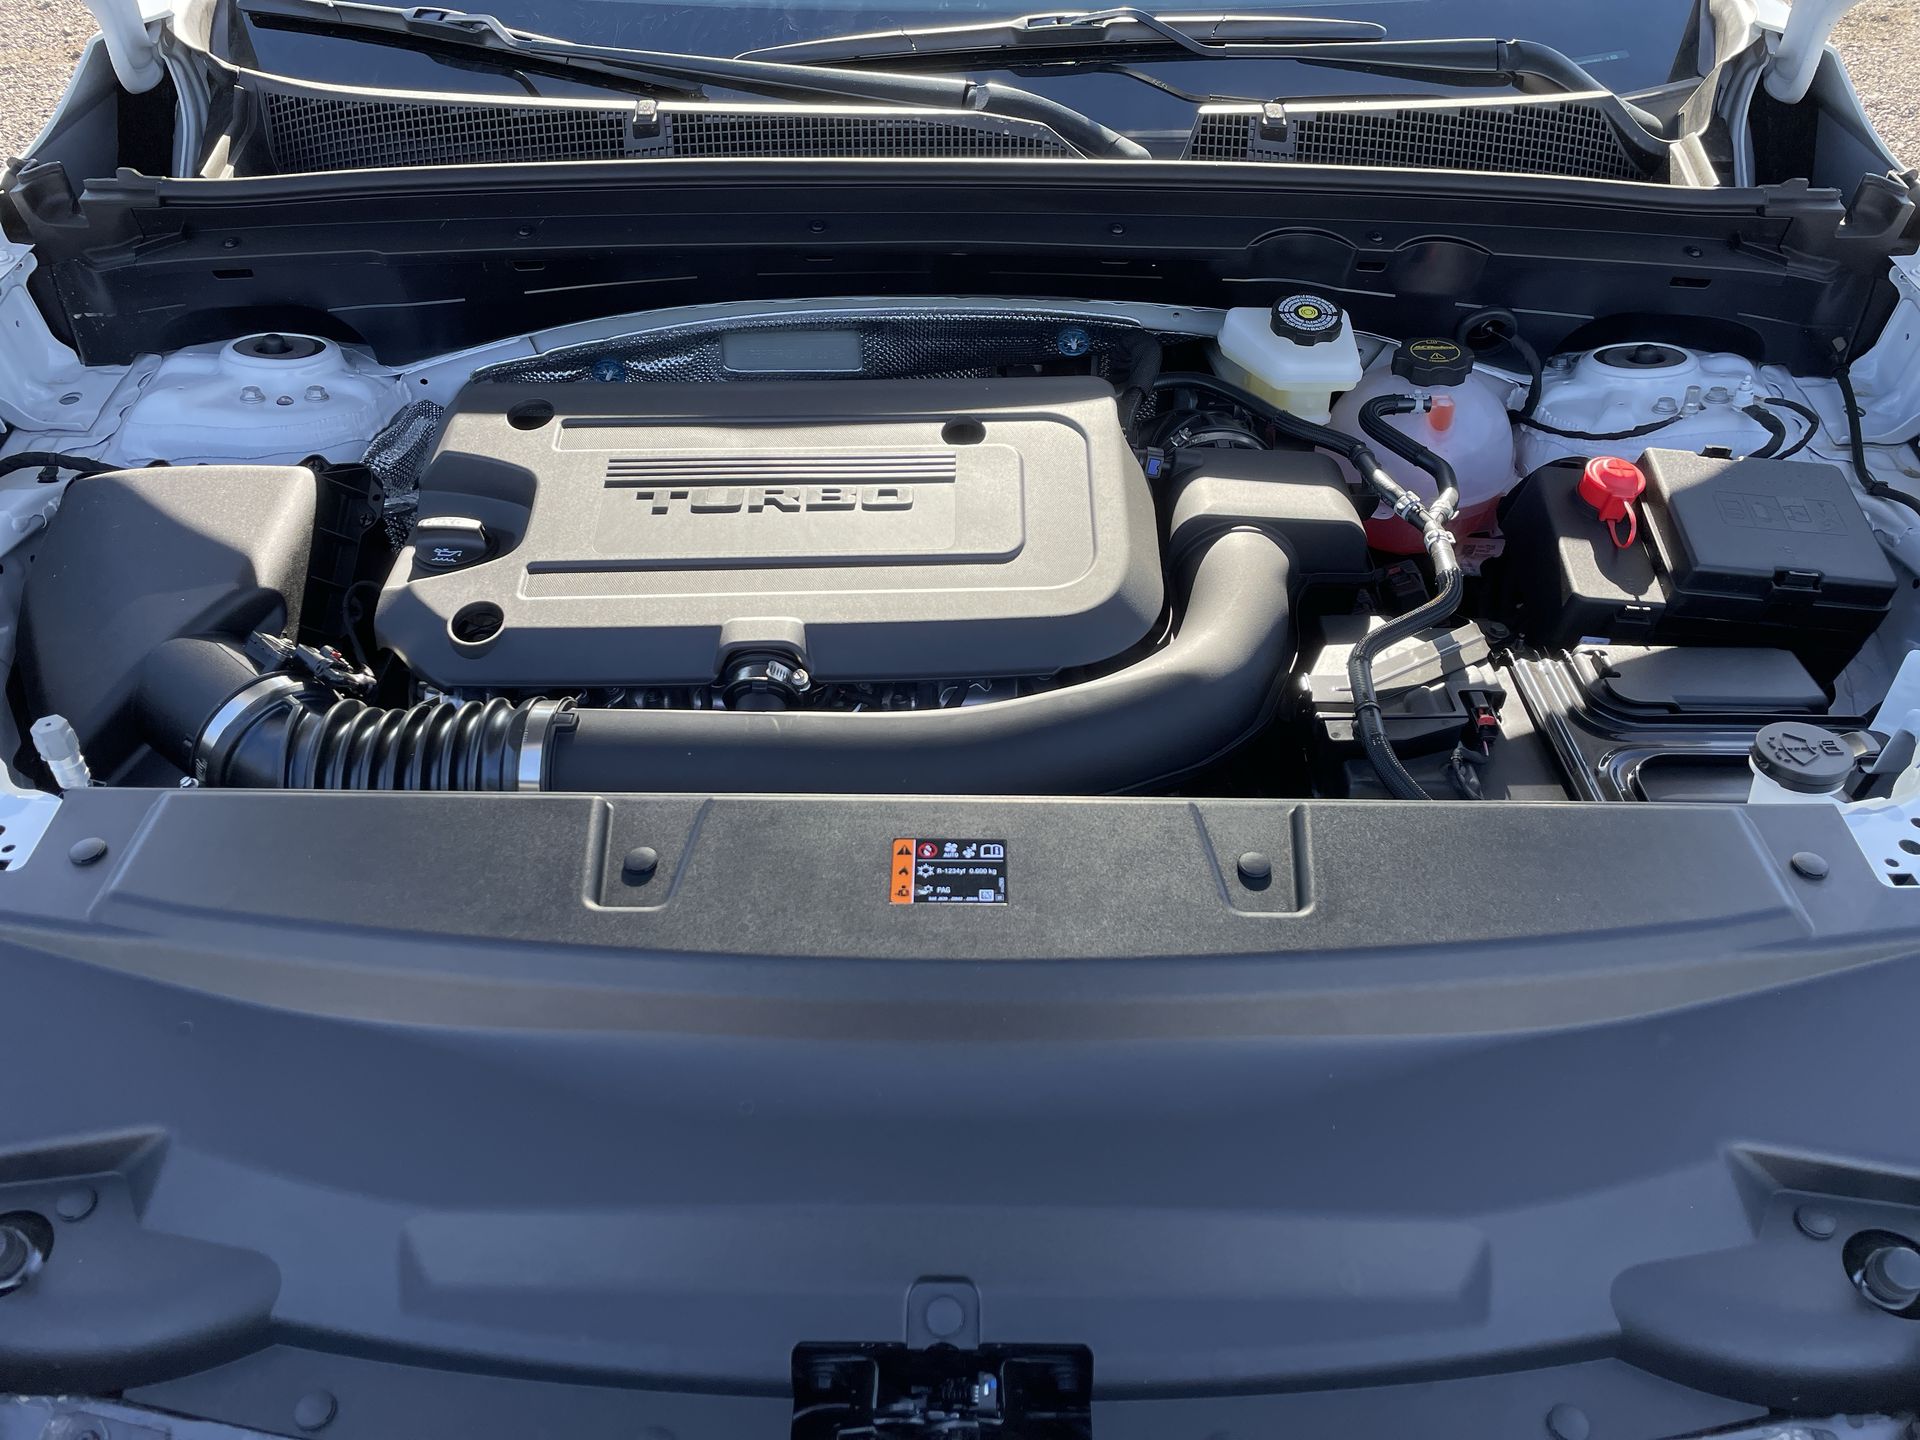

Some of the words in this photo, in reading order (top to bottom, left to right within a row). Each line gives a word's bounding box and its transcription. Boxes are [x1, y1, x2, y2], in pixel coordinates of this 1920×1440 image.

[635, 486, 914, 516] TURBO
[988, 868, 997, 876] kg
[936, 886, 951, 894] PAG
